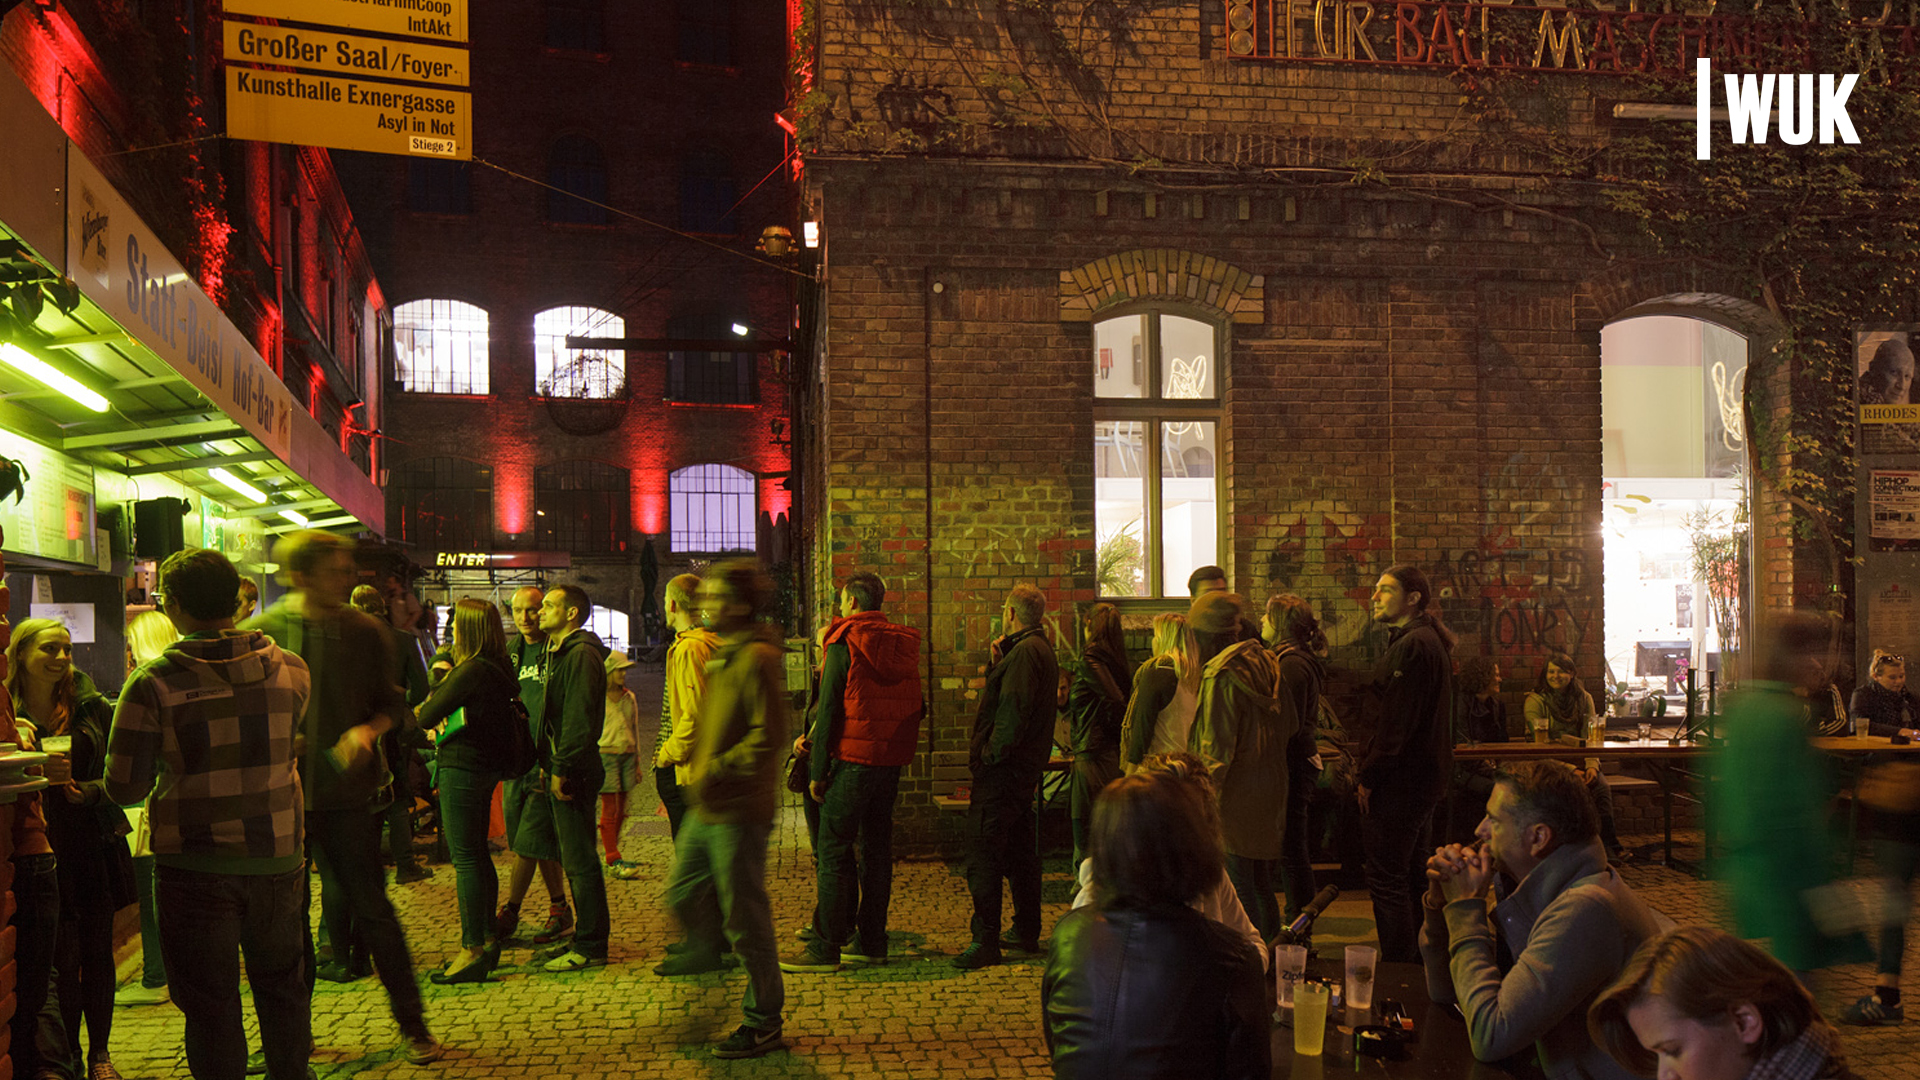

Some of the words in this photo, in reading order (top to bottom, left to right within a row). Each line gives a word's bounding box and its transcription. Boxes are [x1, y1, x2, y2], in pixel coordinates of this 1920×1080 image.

[408, 16, 452, 37] IntAkt
[238, 29, 328, 63] Großer
[238, 72, 341, 103] Kunsthalle
[348, 84, 455, 114] Exnergasse
[378, 113, 408, 132] Asyl
[412, 116, 425, 133] in
[430, 118, 455, 136] Not
[412, 137, 444, 153] Stiege
[446, 141, 453, 152] 2
[233, 347, 275, 434] Hof-Bar
[1864, 407, 1918, 420] RHODES
[1874, 477, 1909, 485] HIPHOP
[436, 552, 486, 566] ENTER
